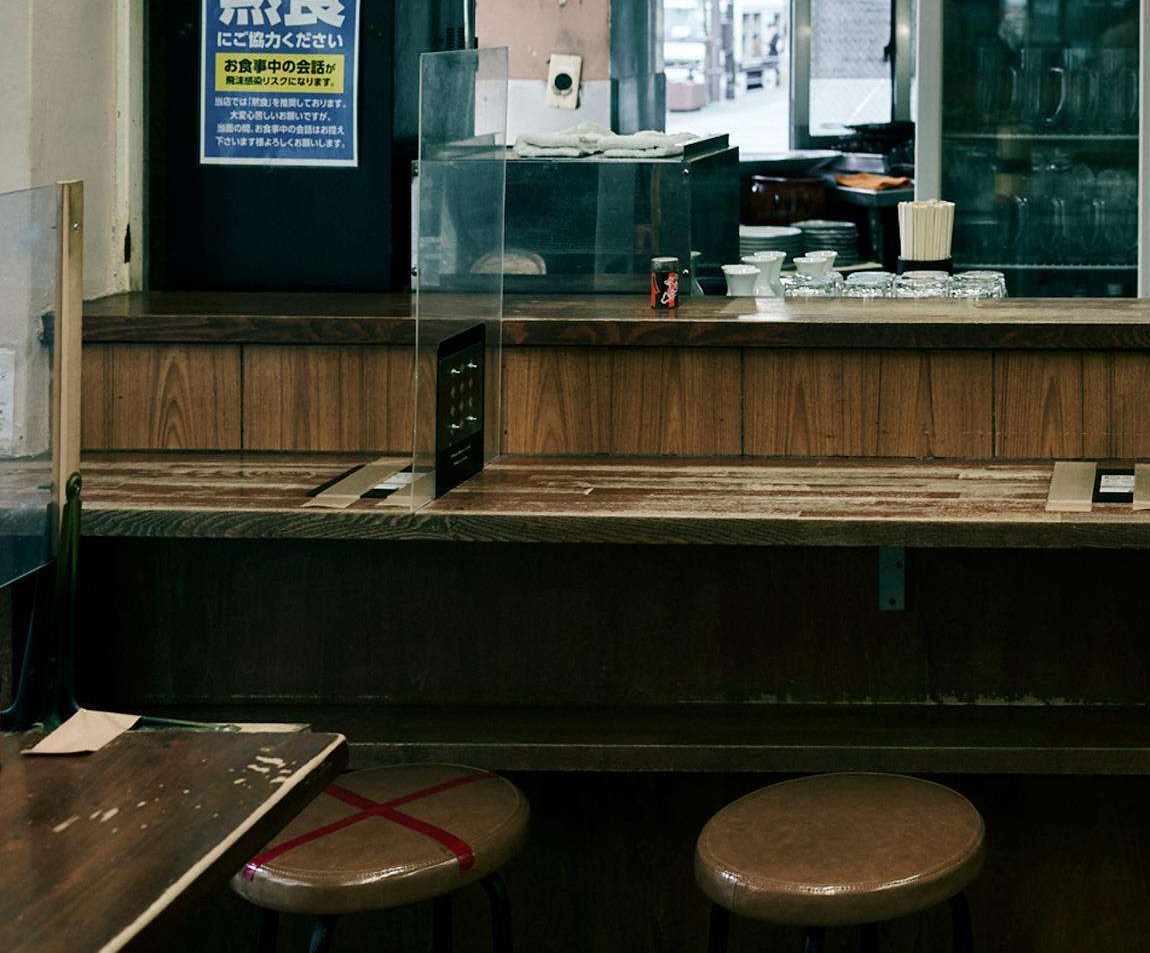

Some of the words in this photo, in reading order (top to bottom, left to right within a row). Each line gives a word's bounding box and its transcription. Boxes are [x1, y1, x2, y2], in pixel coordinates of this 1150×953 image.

[217, 31, 343, 49] にご協力ください
[224, 58, 336, 75] お食事中の会話が
